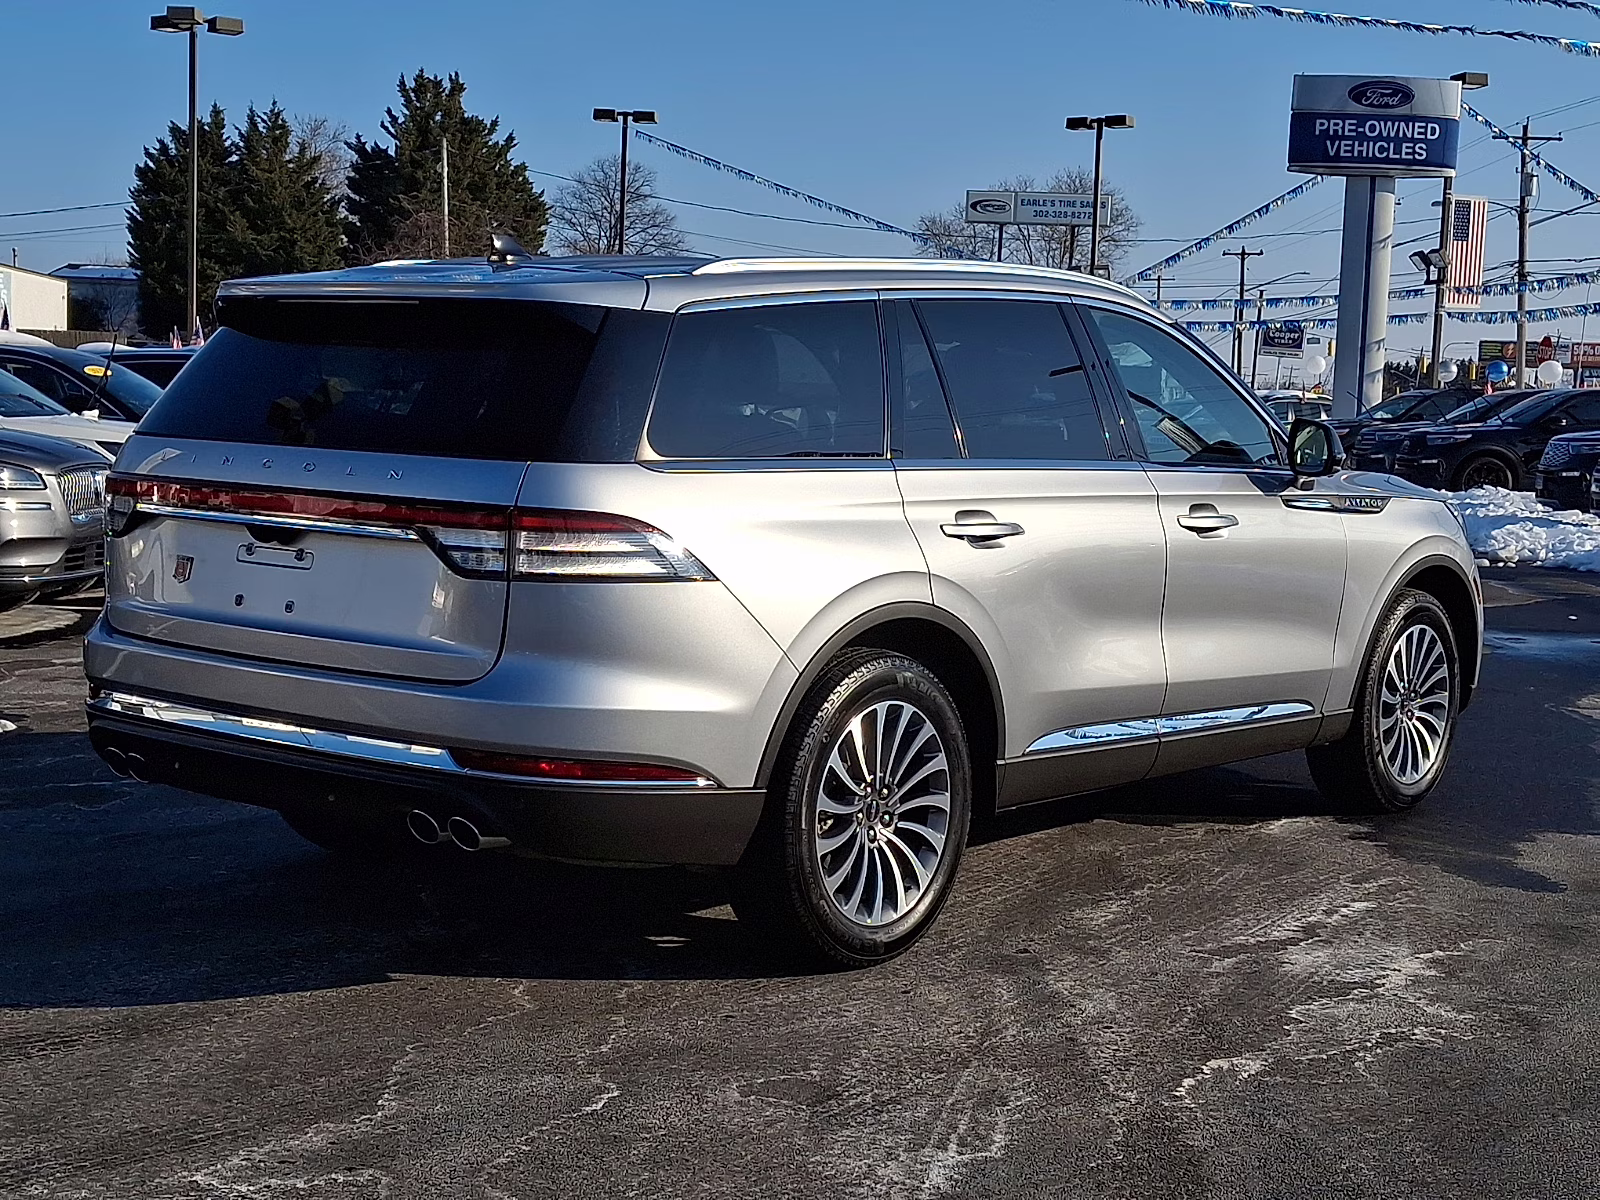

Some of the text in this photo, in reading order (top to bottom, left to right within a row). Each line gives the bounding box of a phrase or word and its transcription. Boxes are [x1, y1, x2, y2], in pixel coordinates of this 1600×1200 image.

[1362, 89, 1402, 105] Ford
[1315, 119, 1440, 140] PRE-OWNED
[1326, 140, 1427, 159] VEHICLES
[1020, 198, 1107, 210] EARLE'S TIRE SALS
[1269, 329, 1300, 340] Cooper
[1538, 346, 1553, 359] STOP
[160, 449, 405, 481] LINCOLN
[1344, 497, 1383, 508] AVIATOR
